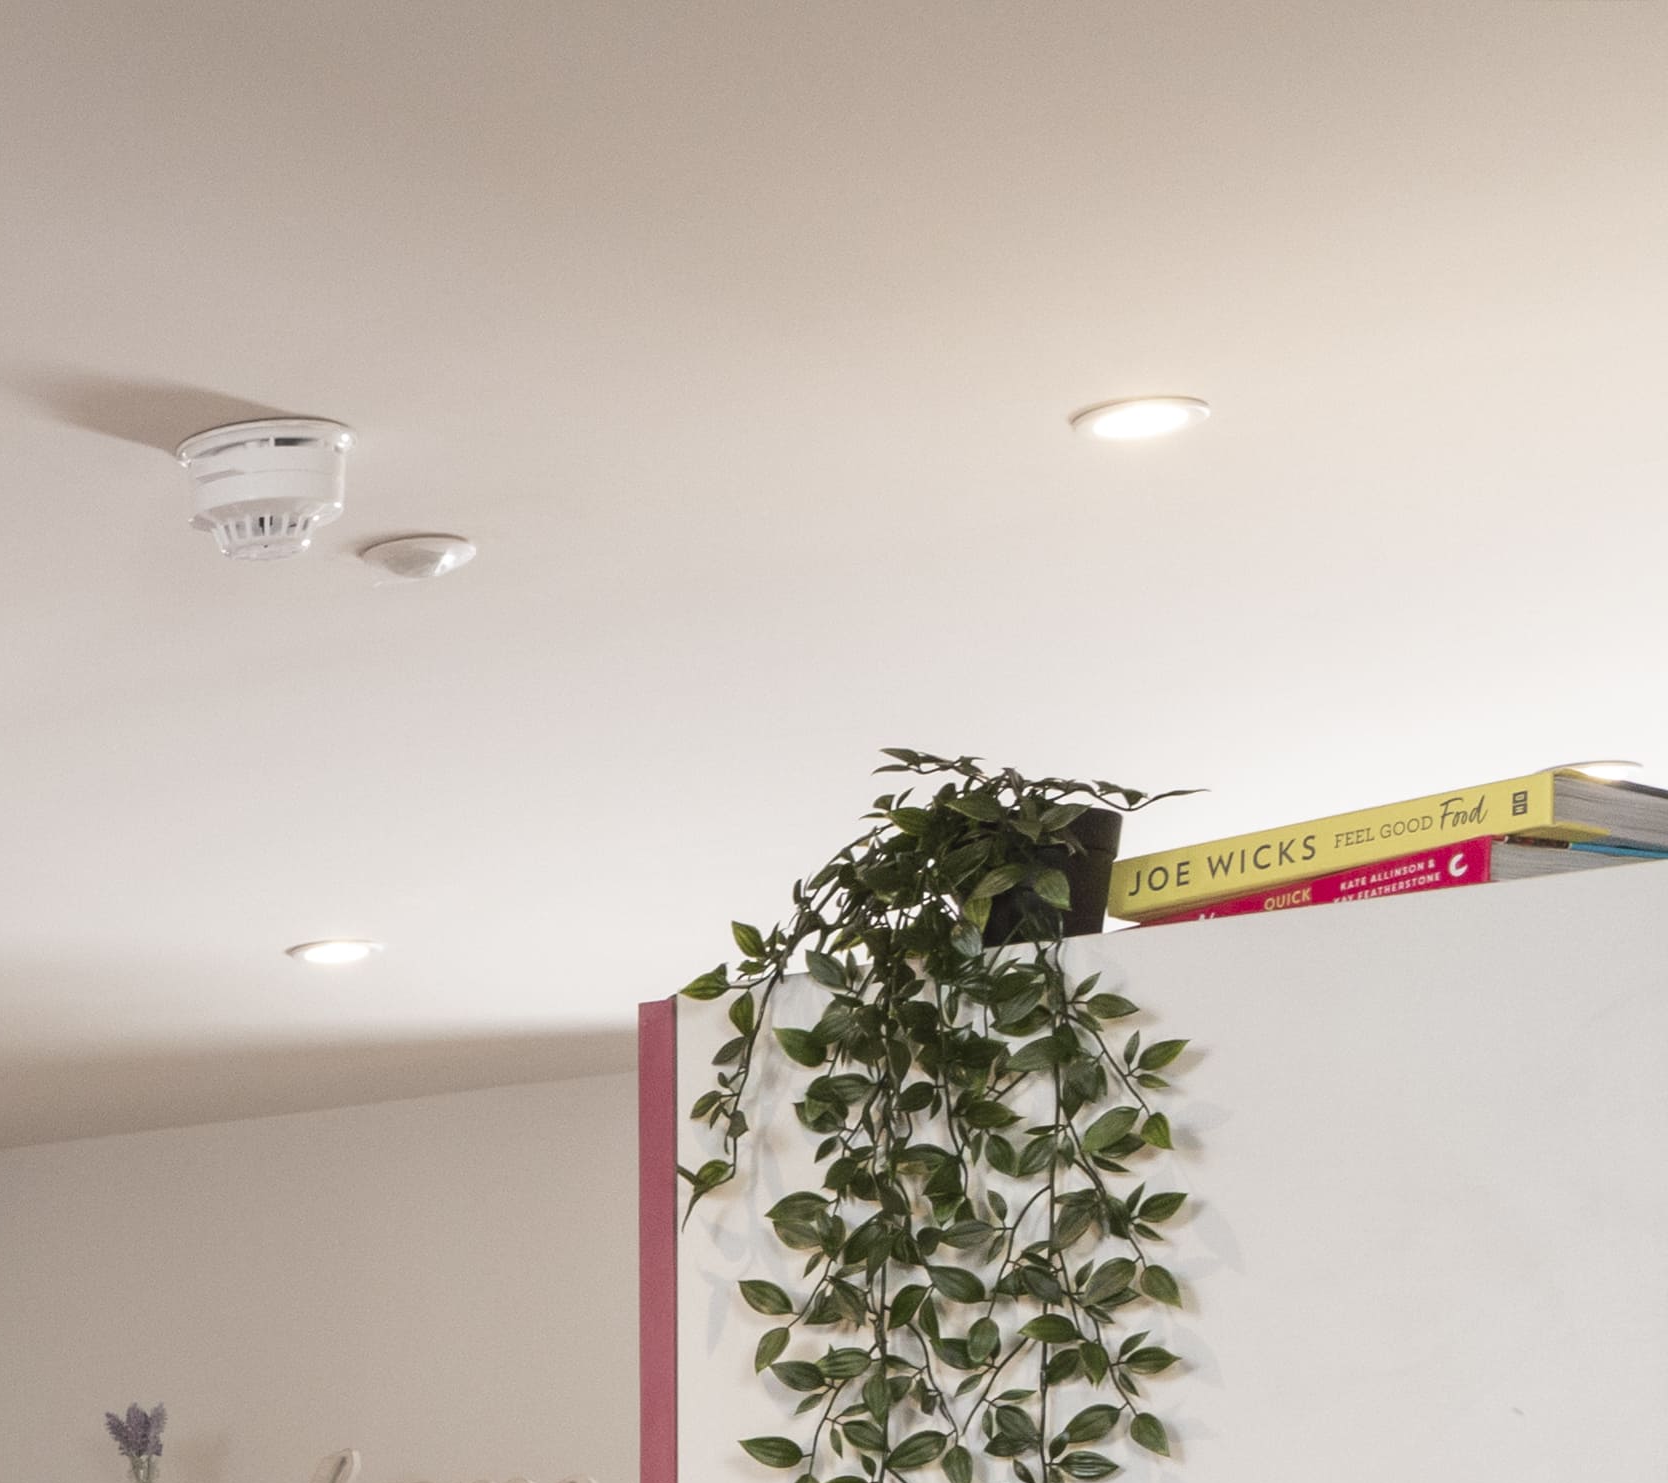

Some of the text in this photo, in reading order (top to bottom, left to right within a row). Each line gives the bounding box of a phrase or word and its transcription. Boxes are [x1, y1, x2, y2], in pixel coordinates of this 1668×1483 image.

[1128, 861, 1190, 896] JOE
[1207, 835, 1316, 879] WICKS
[1334, 827, 1375, 848] FEEL
[1380, 816, 1433, 839] GOOD
[1439, 795, 1488, 831] Food
[1340, 876, 1367, 891] KATE
[1370, 862, 1425, 883] ALLINSON
[1357, 872, 1441, 900] FEATHERSTONE
[1263, 888, 1311, 911] QUICK
